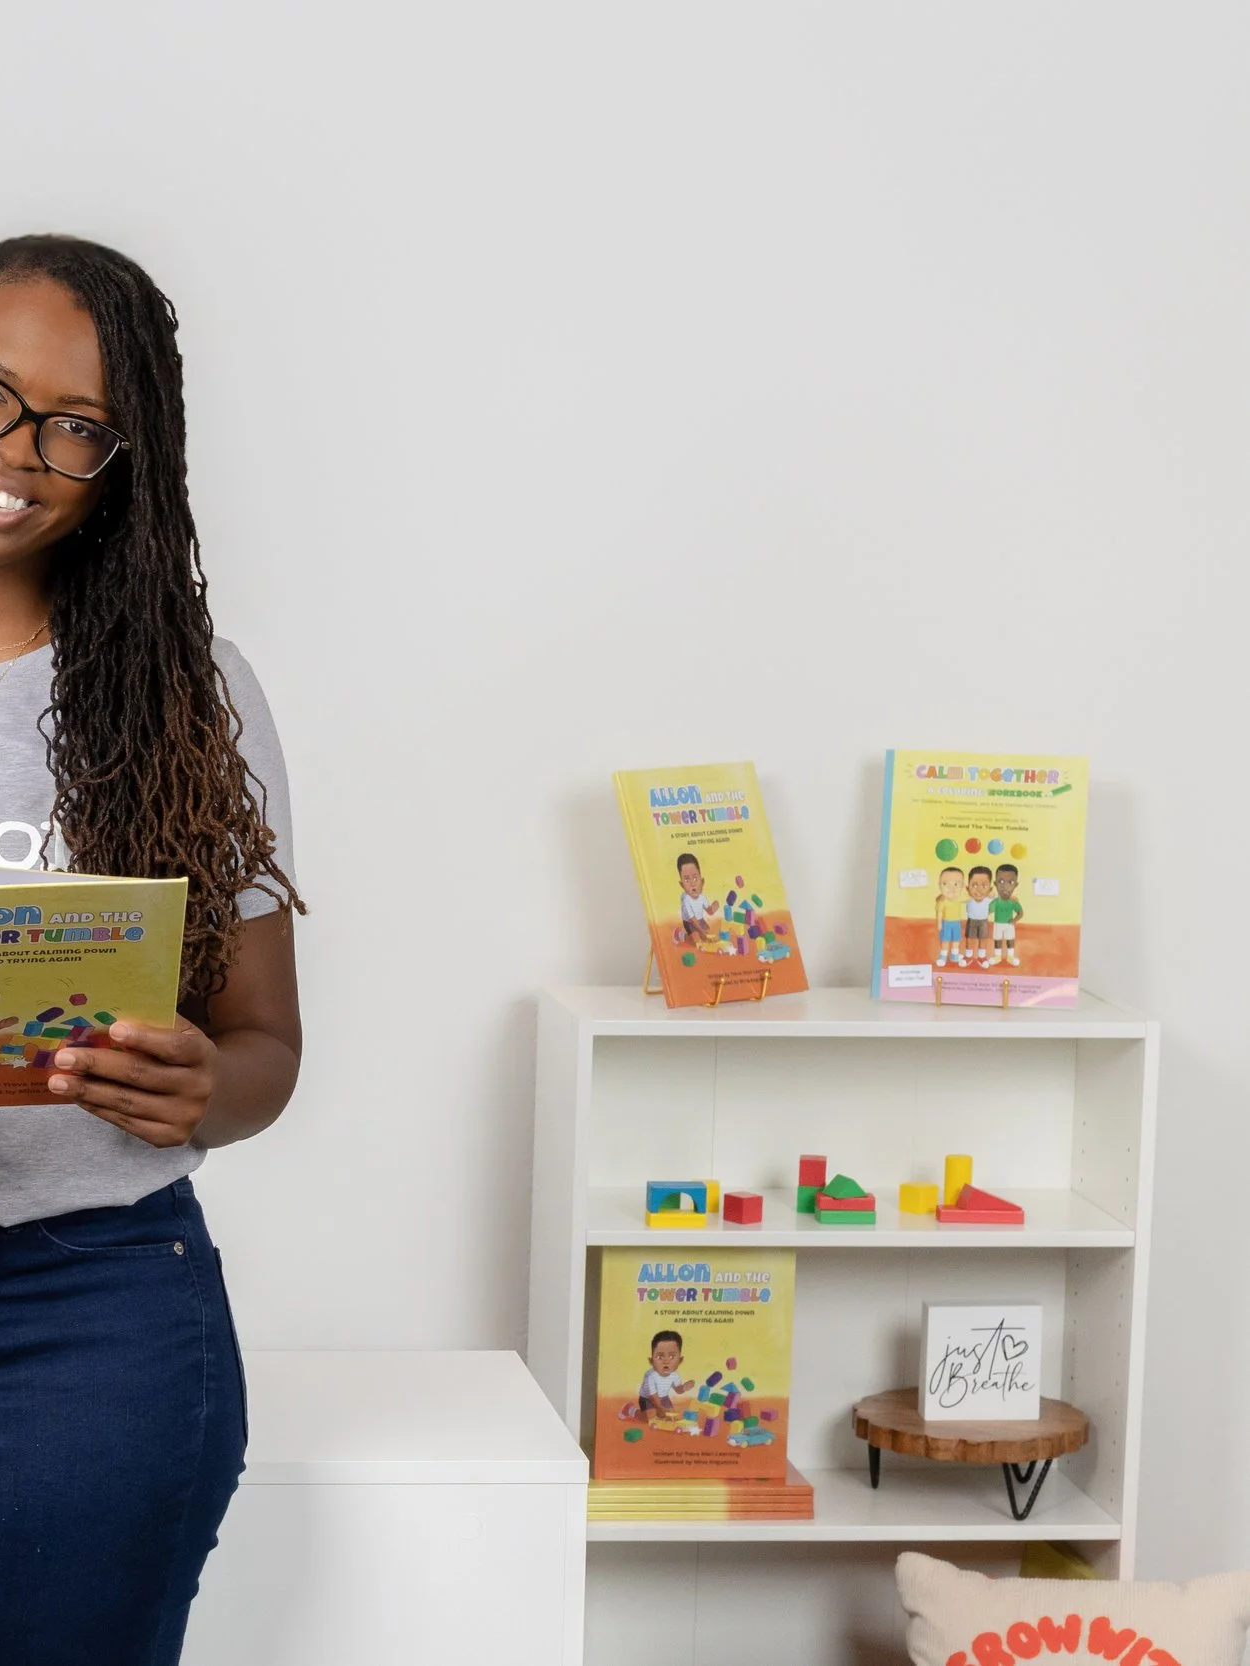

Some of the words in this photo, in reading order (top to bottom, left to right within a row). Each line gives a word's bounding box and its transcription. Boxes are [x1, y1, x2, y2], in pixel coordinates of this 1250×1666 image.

[915, 765, 964, 780] CALM
[967, 766, 1060, 784] TOGETHER
[987, 788, 1043, 798] WORKBOOK
[652, 809, 698, 826] TOWER
[49, 912, 95, 924] AND
[100, 911, 144, 923] THE
[26, 926, 146, 944] TUMBLE
[33, 948, 82, 956] CALMING
[637, 1262, 712, 1284] ALLON
[715, 1272, 742, 1283] AND
[744, 1272, 771, 1283] THE
[636, 1287, 698, 1302] TOWER
[701, 1287, 772, 1303] TUMBLE
[929, 1318, 1026, 1394] just
[938, 1361, 1036, 1408] Breathe
